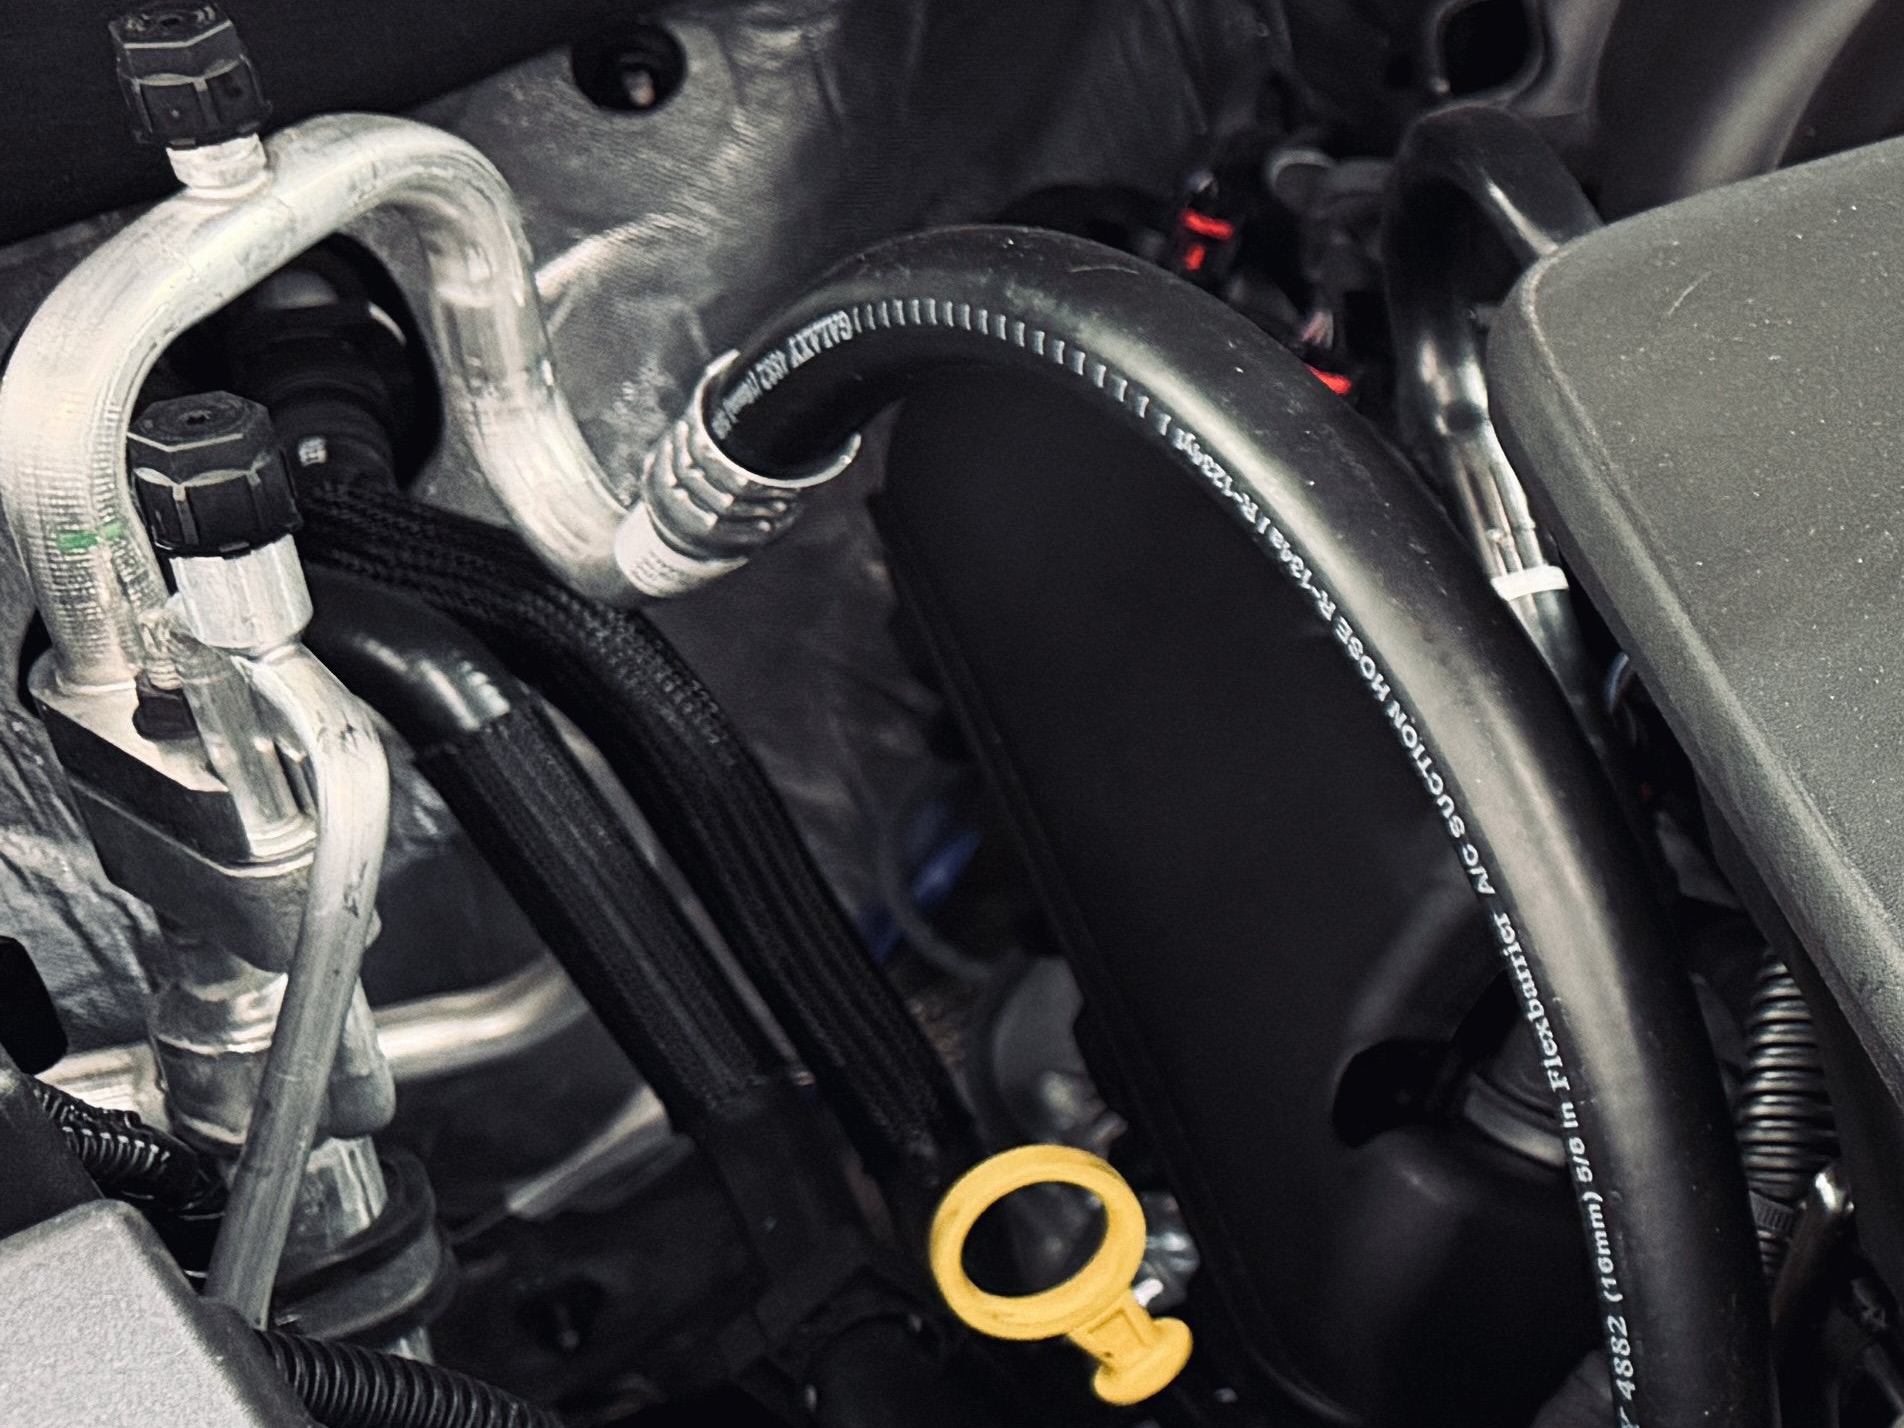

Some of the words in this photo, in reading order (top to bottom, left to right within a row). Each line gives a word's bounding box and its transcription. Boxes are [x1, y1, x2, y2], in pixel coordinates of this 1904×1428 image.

[1332, 615, 1391, 702] HOSE
[1386, 699, 1466, 839] SUCTION
[1461, 842, 1496, 895] A/C
[1606, 1315, 1637, 1401] 4882
